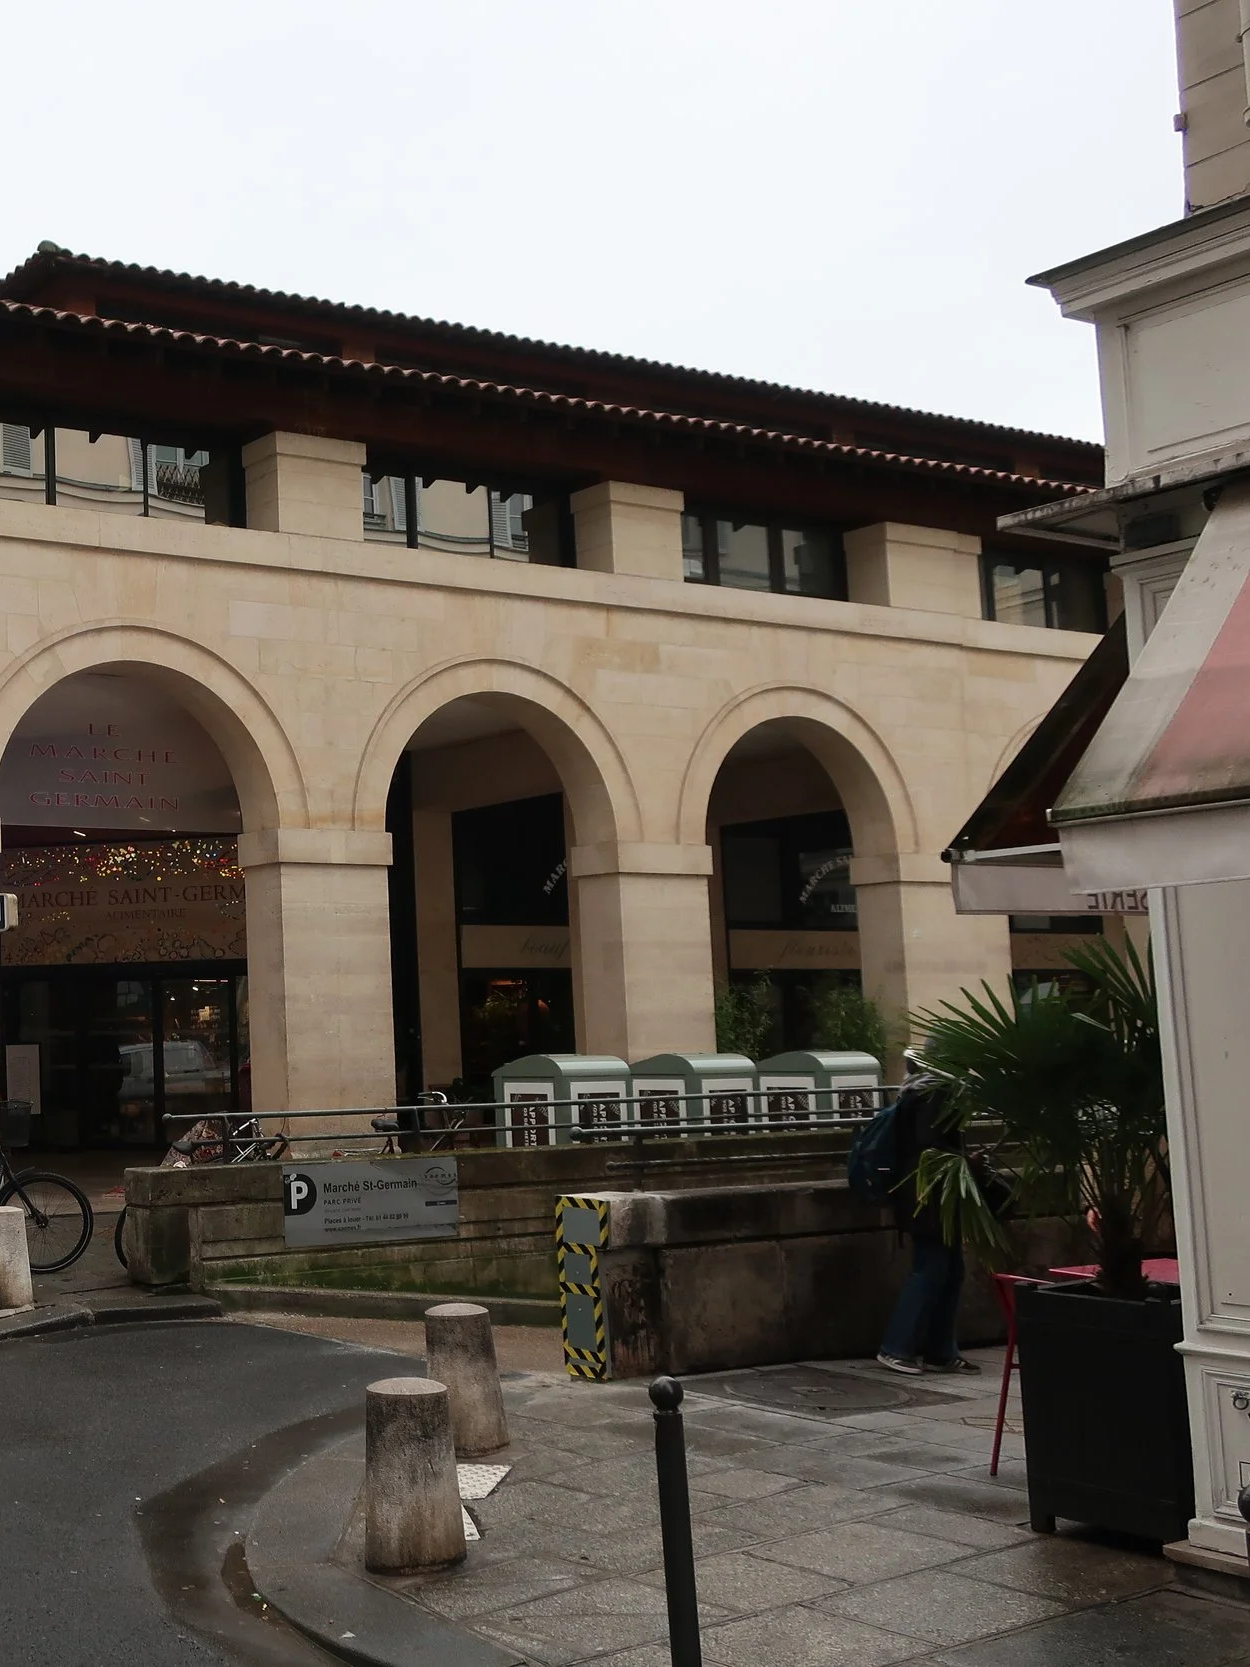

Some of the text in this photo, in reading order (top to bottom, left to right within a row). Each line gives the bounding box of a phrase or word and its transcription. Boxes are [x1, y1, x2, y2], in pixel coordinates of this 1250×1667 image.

[88, 723, 120, 738] LE
[29, 743, 179, 764] MARCHE
[58, 769, 150, 786] SAINT
[29, 791, 179, 811] GERMAIN
[105, 907, 186, 921] ALIMENTAIRE
[323, 1178, 418, 1194] Marché St-Germain
[290, 1180, 308, 1209] P
[324, 1217, 342, 1225] Places
